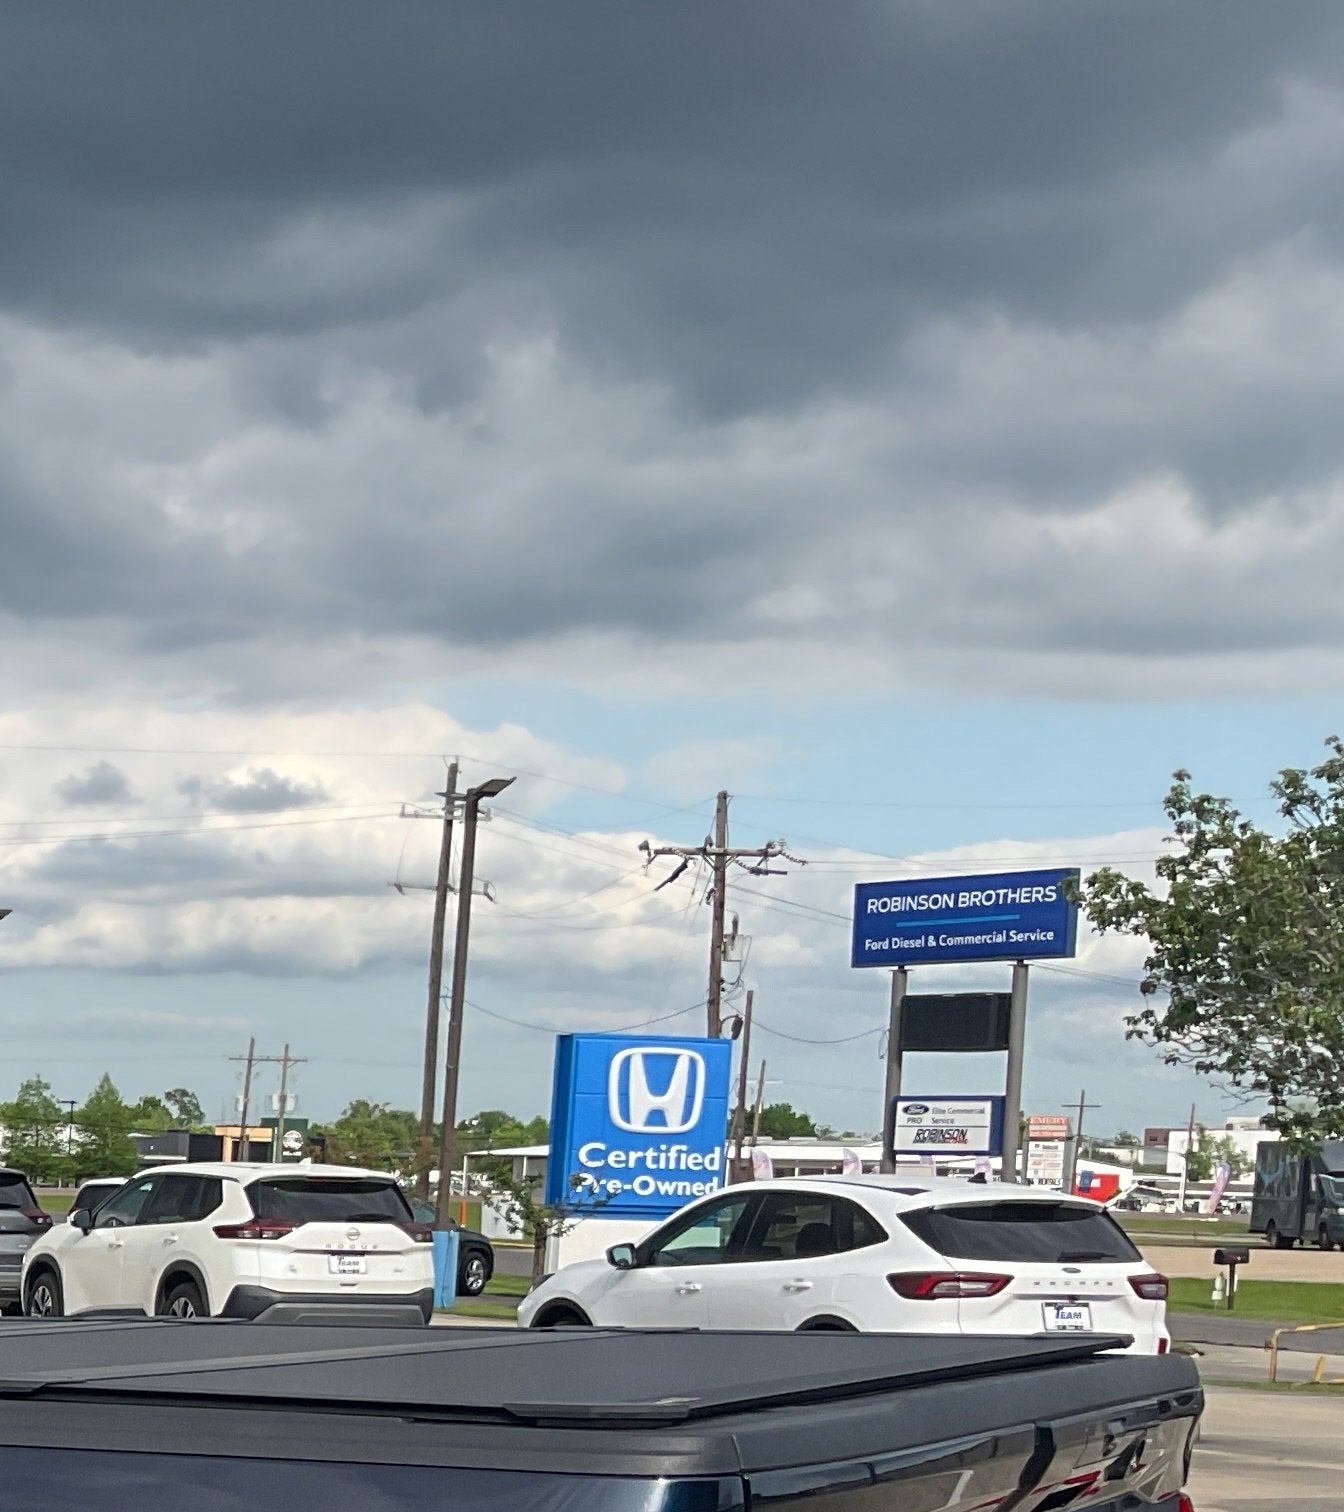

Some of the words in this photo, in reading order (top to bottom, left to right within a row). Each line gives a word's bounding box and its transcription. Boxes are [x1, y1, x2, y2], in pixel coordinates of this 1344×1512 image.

[866, 892, 955, 915] ROBINSON
[957, 884, 1058, 908] BROTHERS
[864, 938, 889, 951] Ford
[891, 934, 925, 950] Diesel
[927, 935, 937, 948] &
[938, 929, 1007, 946] Commercial
[1008, 927, 1055, 943] Service
[914, 1128, 968, 1141] ROBINSON
[577, 1141, 721, 1171] Certified
[575, 1172, 719, 1197] Pre-Owned
[1053, 1303, 1083, 1320] TEAM
